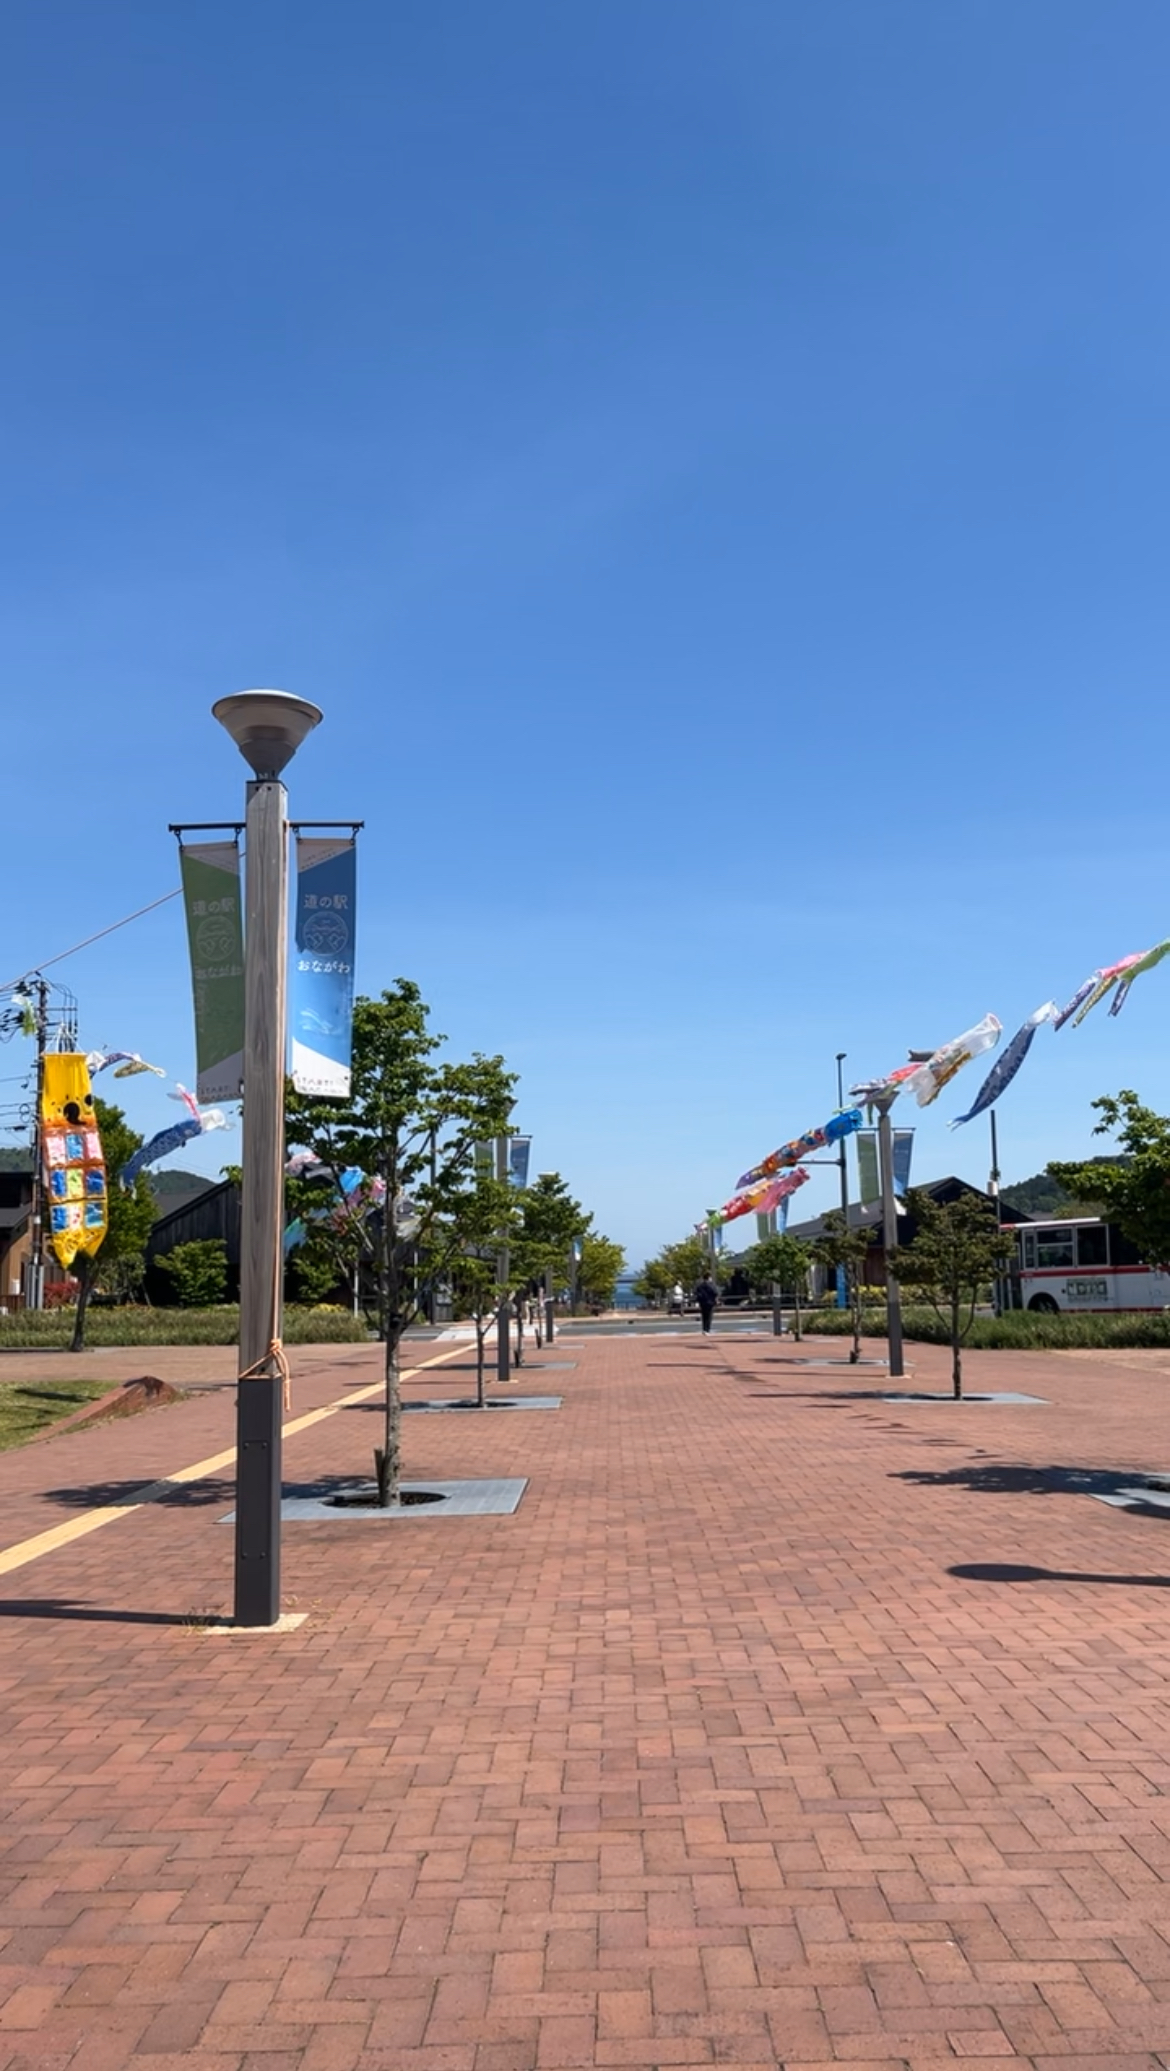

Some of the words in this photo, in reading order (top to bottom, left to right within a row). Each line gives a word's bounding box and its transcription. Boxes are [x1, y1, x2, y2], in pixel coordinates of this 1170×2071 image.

[303, 894, 349, 910] 道の駅
[297, 960, 350, 974] おながわ
